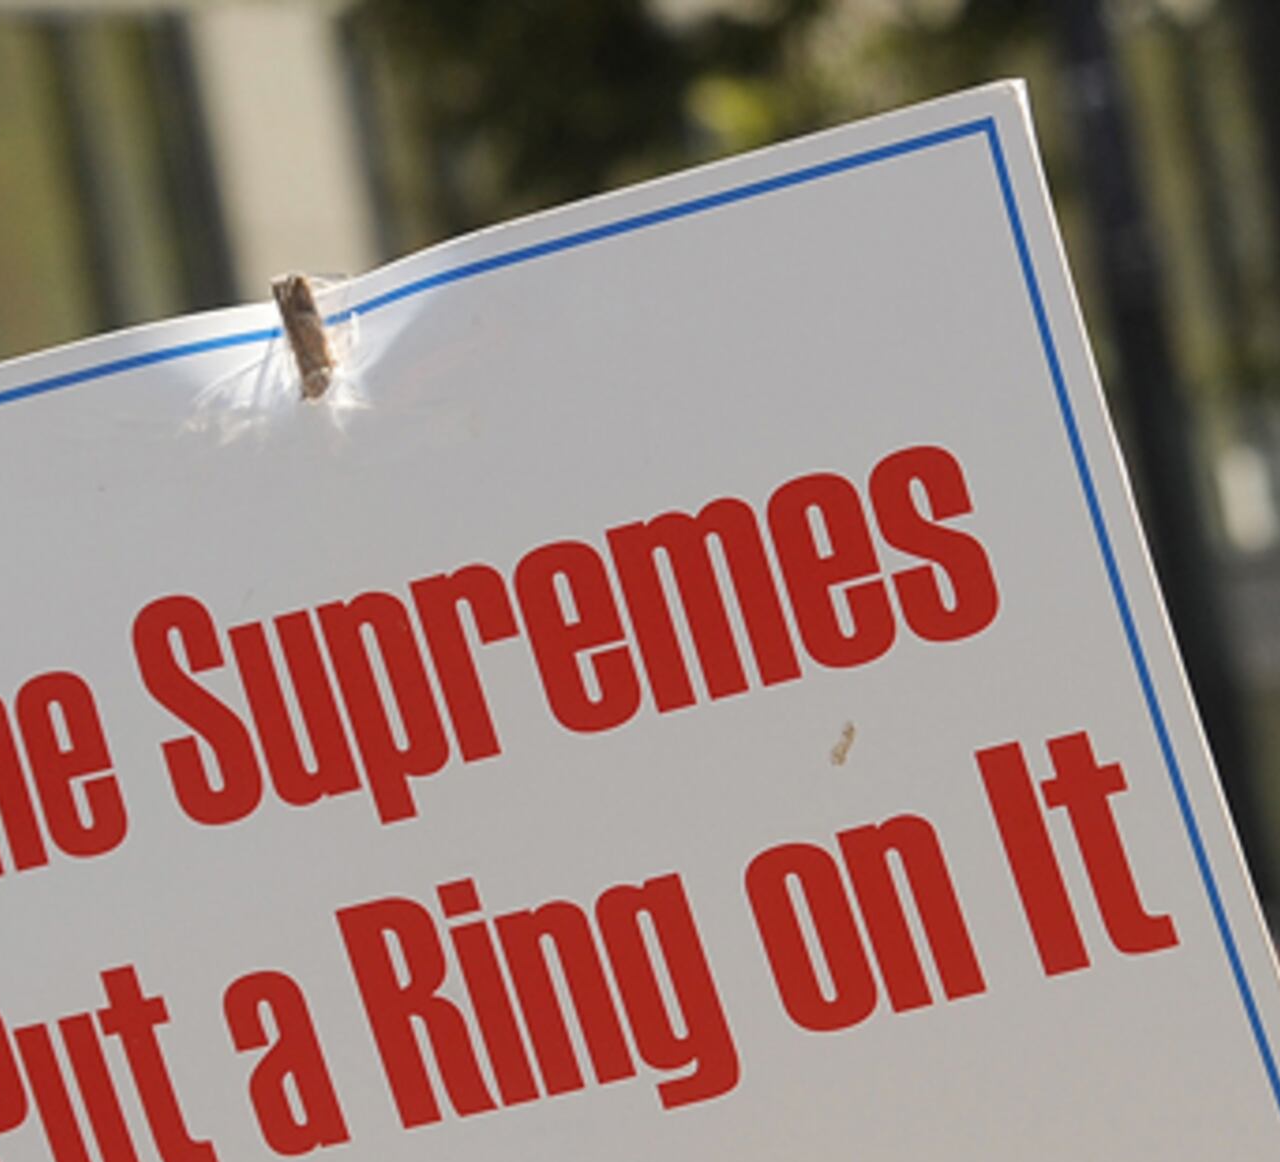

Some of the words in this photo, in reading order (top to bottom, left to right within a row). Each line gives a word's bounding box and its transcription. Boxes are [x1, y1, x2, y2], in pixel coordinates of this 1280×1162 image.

[132, 446, 1000, 825] Supremes
[224, 971, 351, 1156] a
[336, 872, 741, 1130] Ring
[745, 814, 986, 1032] on
[976, 731, 1179, 977] It
